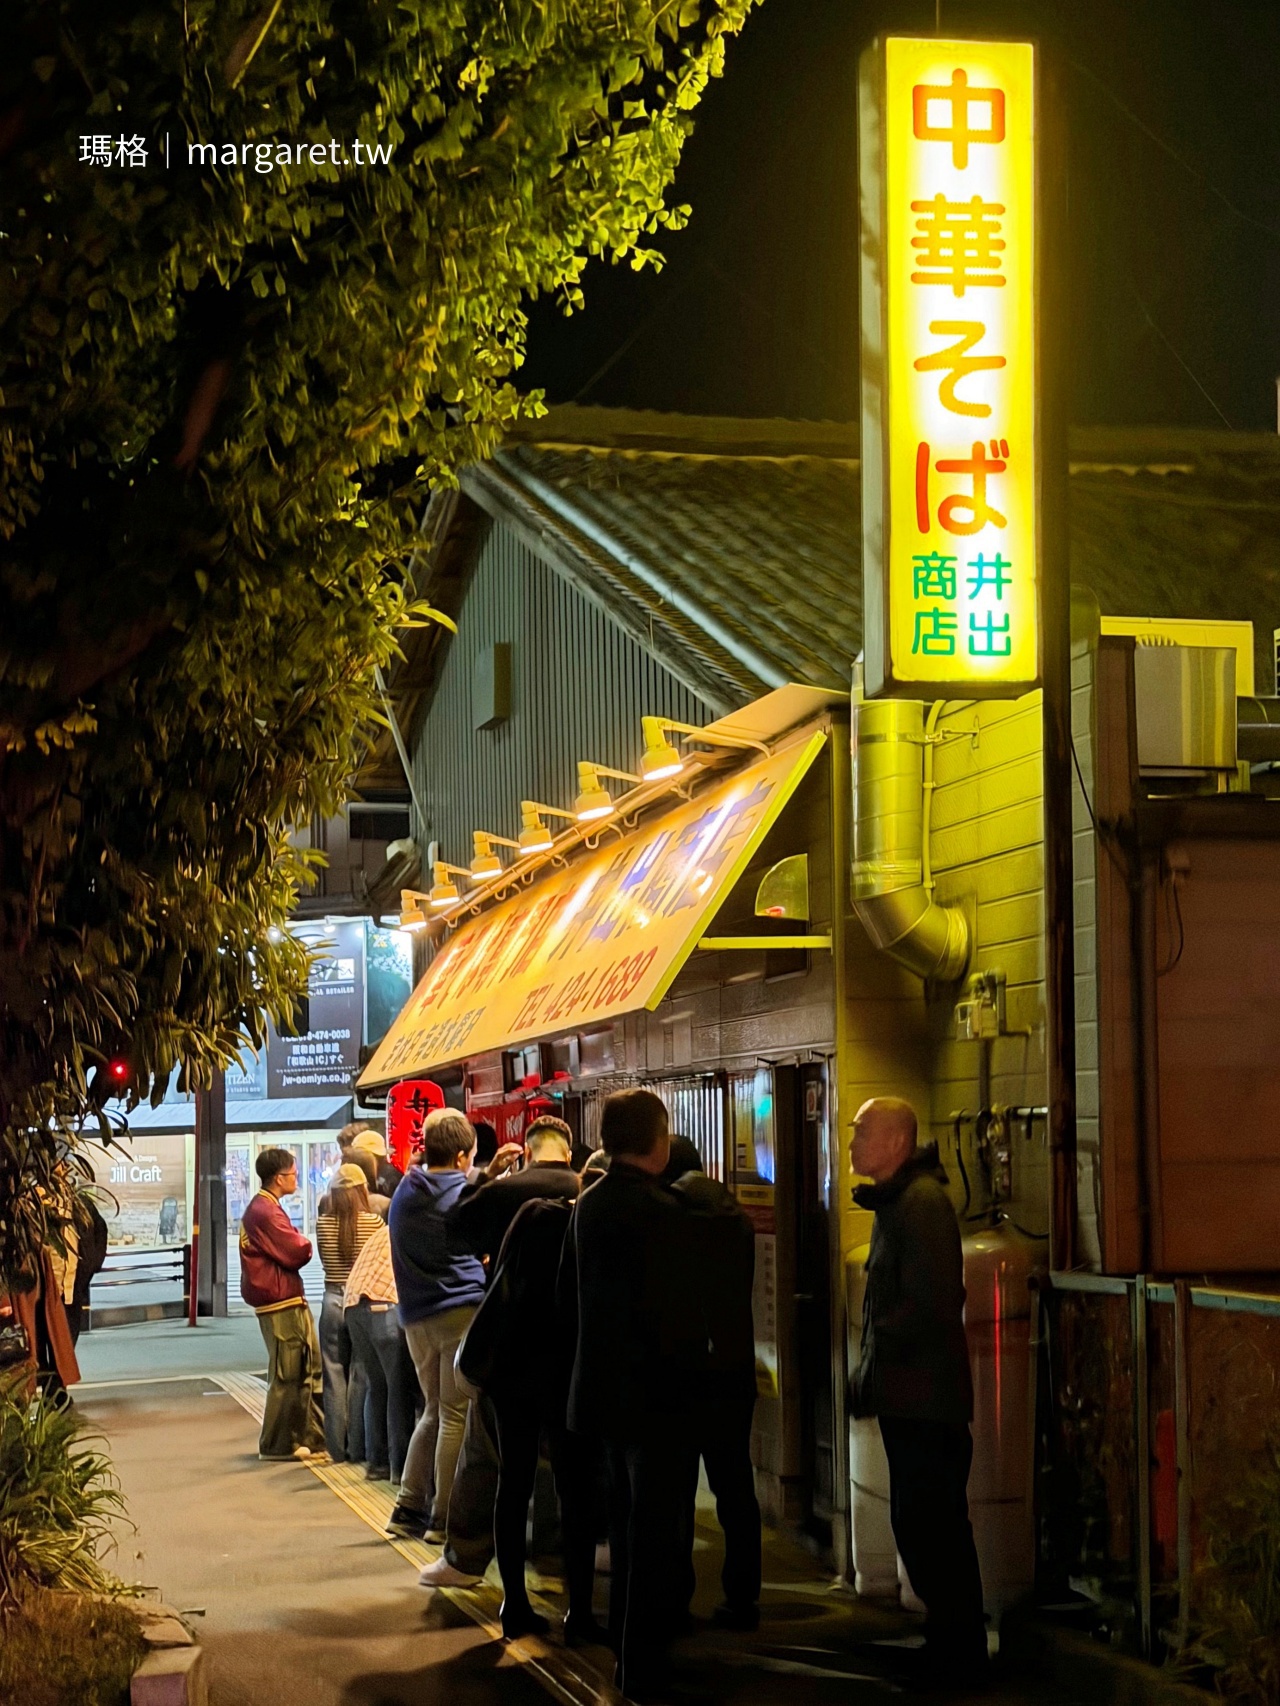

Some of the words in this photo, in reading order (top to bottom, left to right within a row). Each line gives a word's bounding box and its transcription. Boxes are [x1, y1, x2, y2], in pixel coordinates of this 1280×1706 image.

[911, 67, 1010, 536] 中華そば
[507, 983, 555, 1034] TEL
[543, 945, 659, 1024] 424-1689
[110, 1166, 127, 1183] Jill
[130, 1165, 162, 1182] Craft
